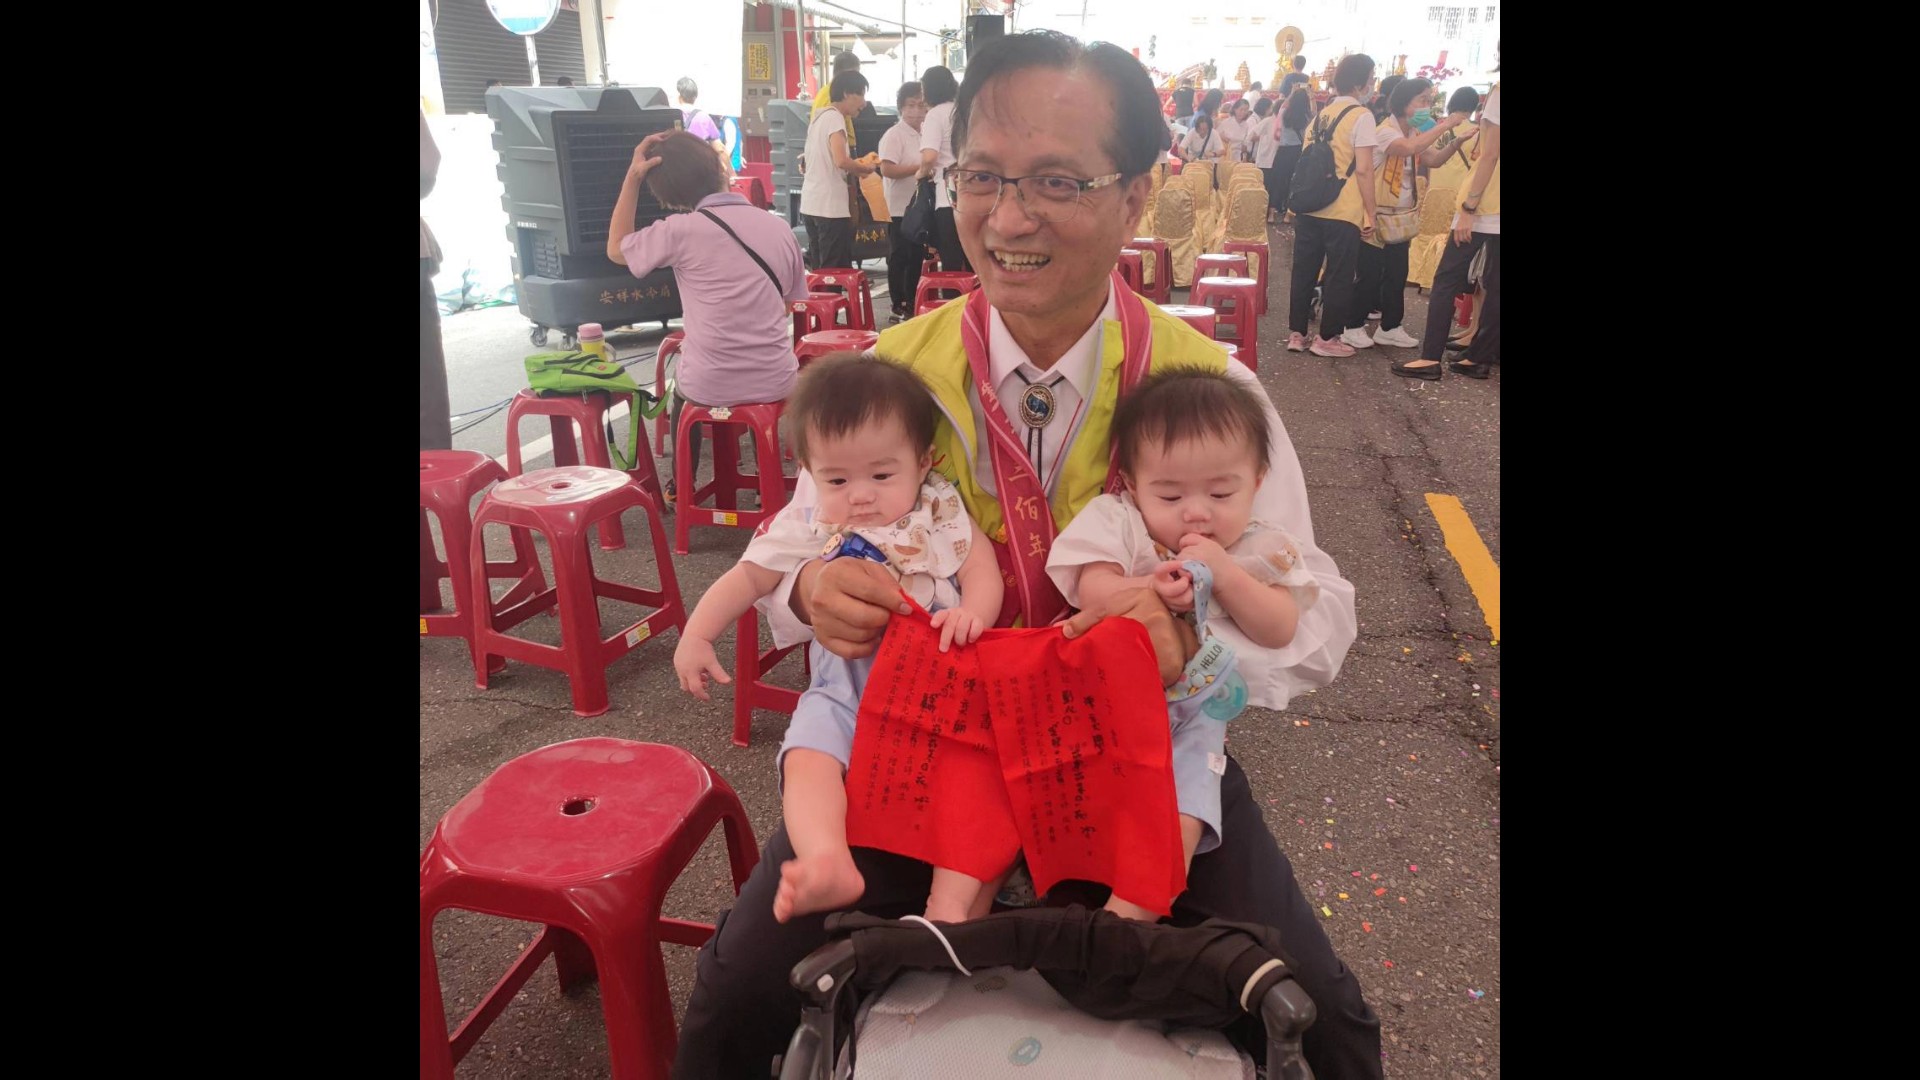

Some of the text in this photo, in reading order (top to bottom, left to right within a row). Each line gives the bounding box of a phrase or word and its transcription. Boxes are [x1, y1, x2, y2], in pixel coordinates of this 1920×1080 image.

[599, 283, 672, 305] 安祥水冷扇
